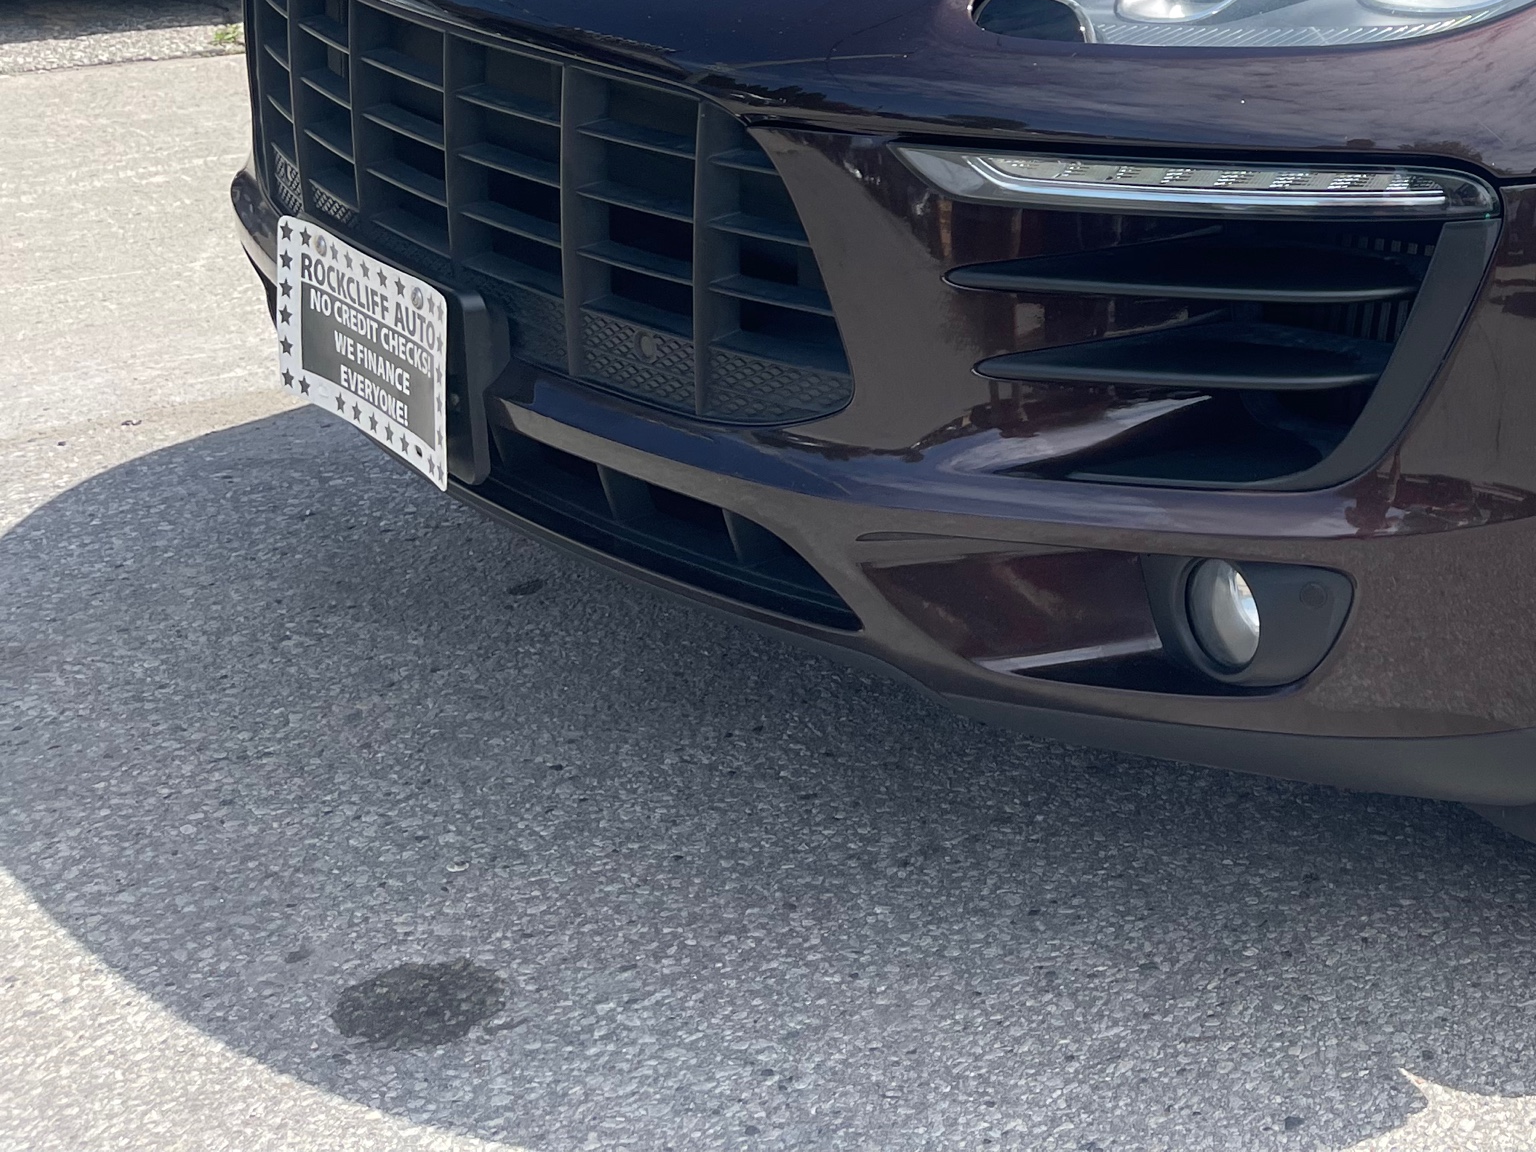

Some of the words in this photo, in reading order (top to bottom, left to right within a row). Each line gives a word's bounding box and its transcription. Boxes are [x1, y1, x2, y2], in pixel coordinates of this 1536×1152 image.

[301, 252, 389, 321] ROCKCLIFF
[394, 302, 435, 348] AUTO
[310, 288, 332, 316] NO
[334, 305, 378, 343] CREDIT
[381, 327, 431, 378] CHECKS!
[334, 330, 355, 361] WE
[356, 342, 410, 396] FINANCE
[340, 364, 409, 427] EVERYONE!
